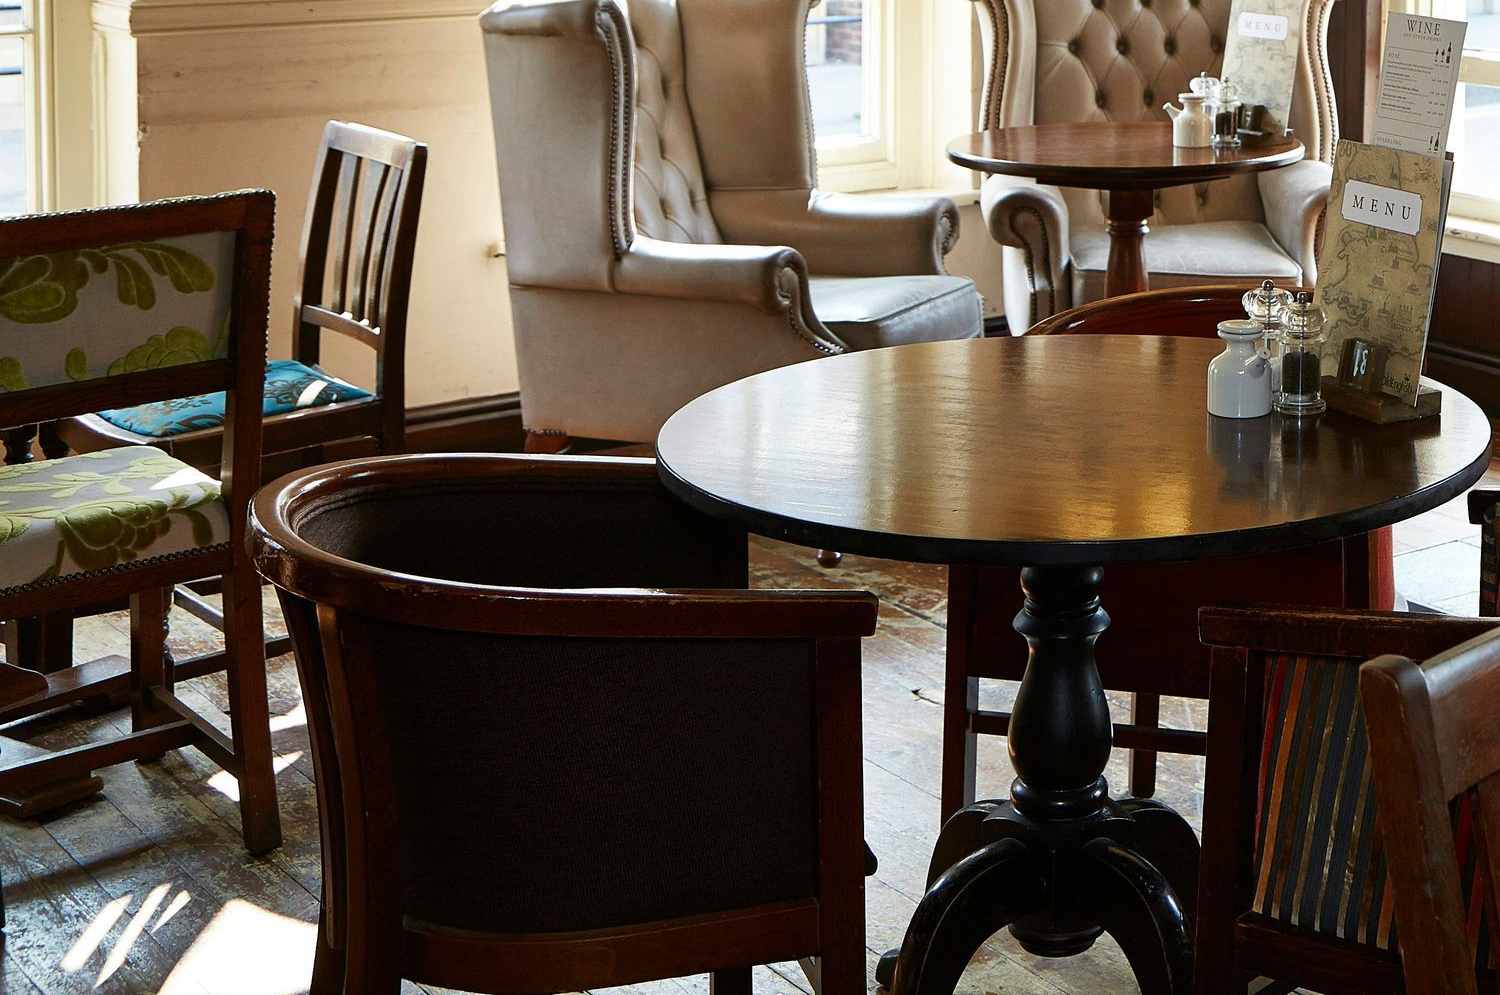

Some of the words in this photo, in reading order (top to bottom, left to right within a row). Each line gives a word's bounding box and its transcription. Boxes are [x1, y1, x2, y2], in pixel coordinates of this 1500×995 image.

[1244, 20, 1281, 32] MENU
[1406, 19, 1441, 36] WINE
[1352, 194, 1412, 221] MENU
